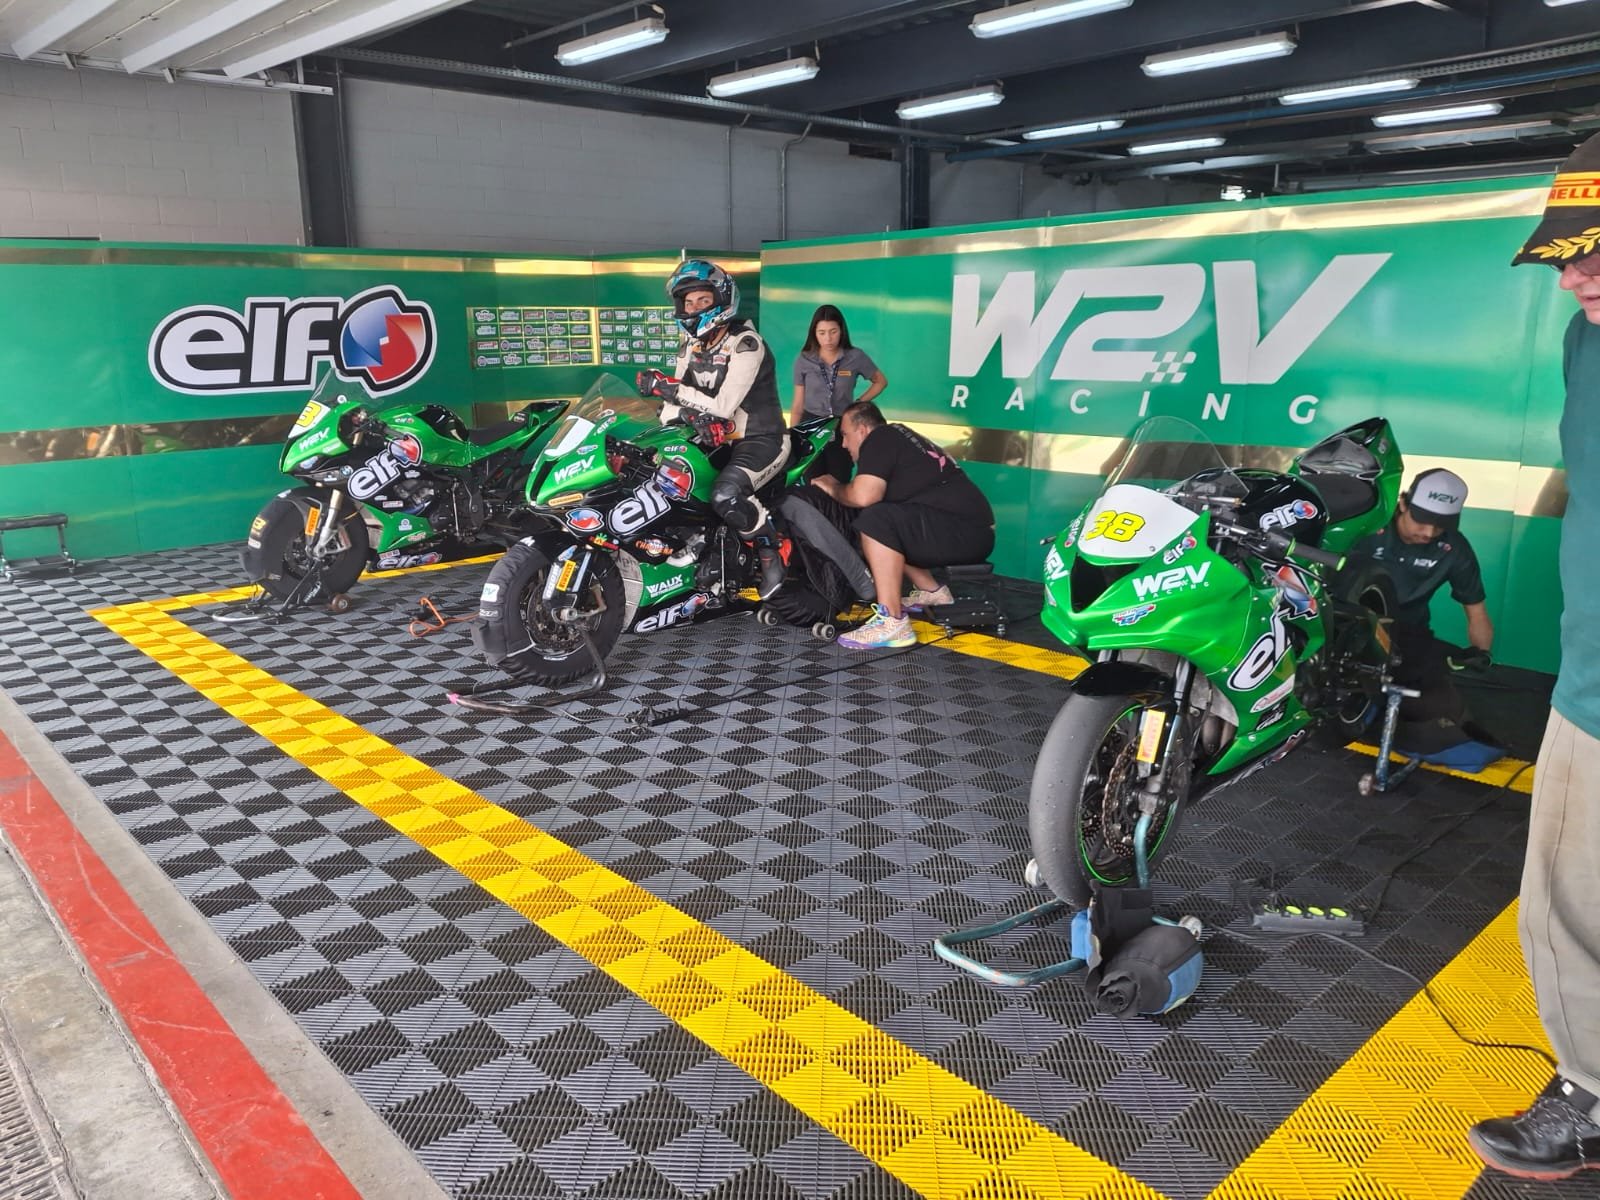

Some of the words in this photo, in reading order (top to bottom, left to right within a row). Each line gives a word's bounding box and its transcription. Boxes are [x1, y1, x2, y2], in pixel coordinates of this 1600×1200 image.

[949, 252, 1393, 384] W2V
[159, 305, 338, 386] elf
[950, 384, 1318, 425] RACING
[350, 452, 399, 499] elf
[554, 454, 596, 485] W2V
[609, 479, 669, 534] elf
[1260, 502, 1297, 531] elf
[1428, 490, 1459, 505] W2V
[1163, 543, 1185, 565] elf
[646, 574, 683, 594] WAUX
[1131, 561, 1212, 599] W2V
[635, 604, 683, 634] elf
[1229, 613, 1291, 691] el
